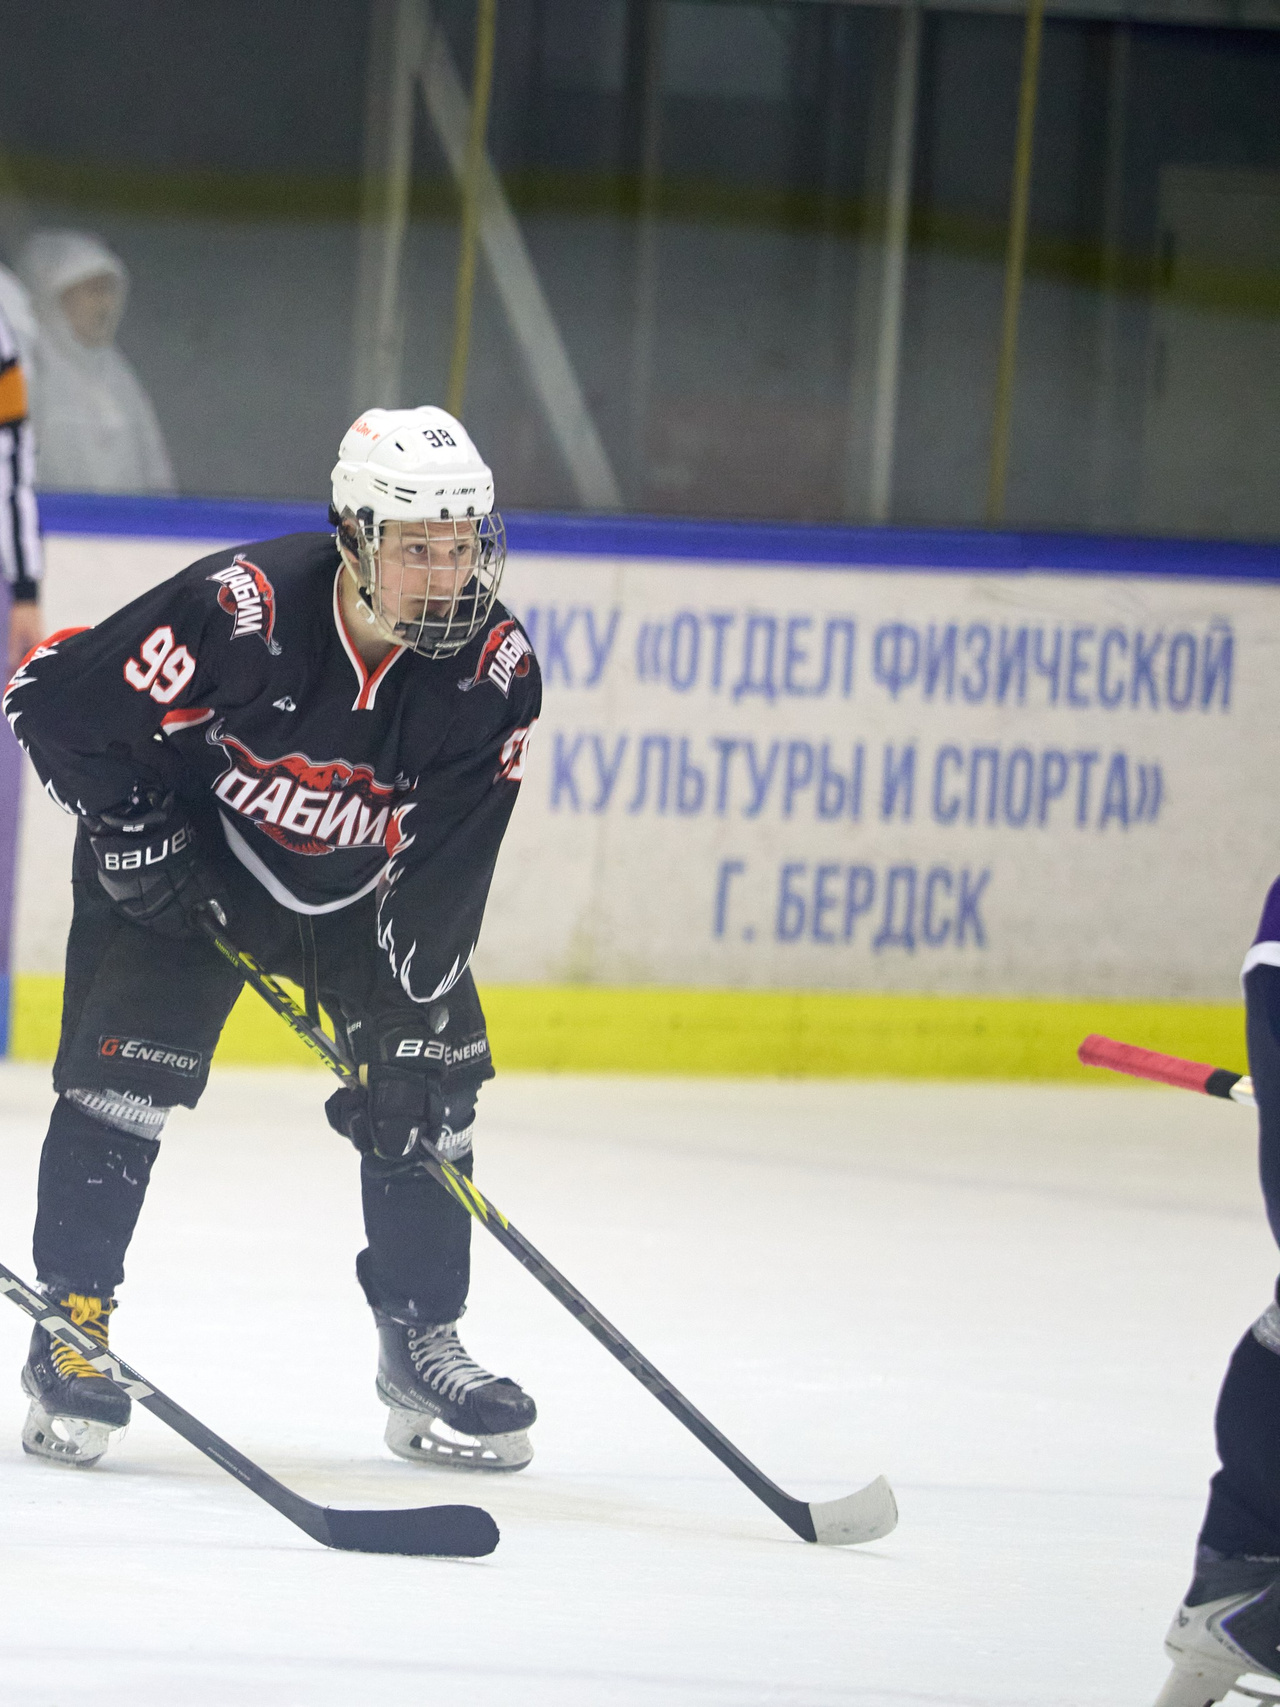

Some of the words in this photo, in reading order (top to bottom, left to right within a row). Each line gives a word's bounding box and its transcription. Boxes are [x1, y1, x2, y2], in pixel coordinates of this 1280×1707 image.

[123, 624, 197, 705] 99
[635, 611, 858, 705] «ОТДЕЛ
[871, 614, 1236, 714] ФИЗИЧЕСКОЙ
[548, 731, 866, 824] КУЛЬТУРЫ
[881, 740, 917, 825] И
[930, 742, 1166, 830] СПОРТА»
[776, 862, 992, 954] БЕРДСК
